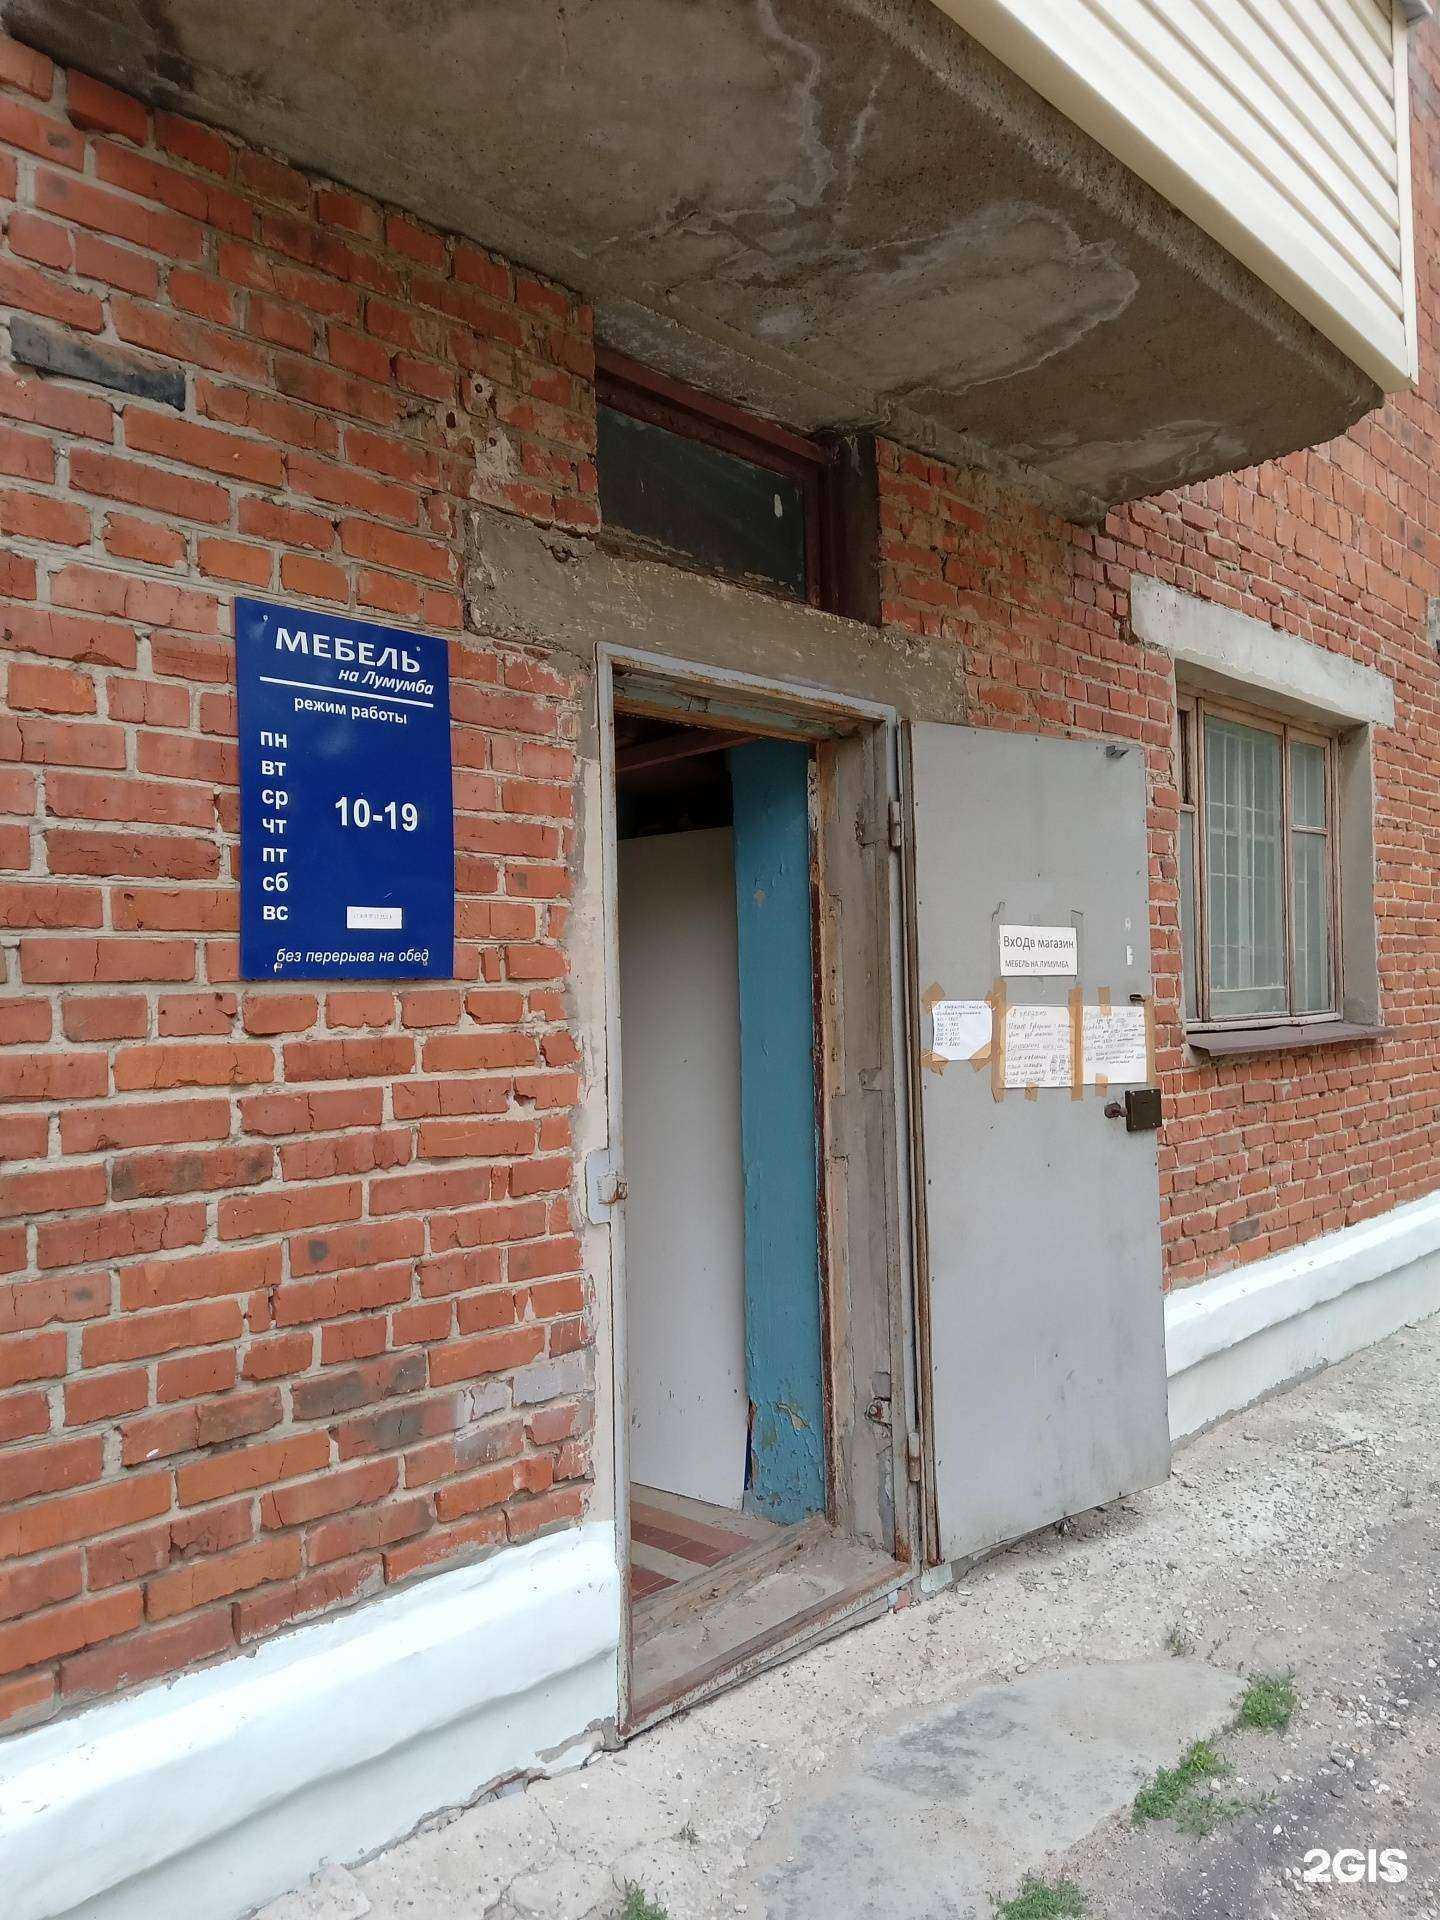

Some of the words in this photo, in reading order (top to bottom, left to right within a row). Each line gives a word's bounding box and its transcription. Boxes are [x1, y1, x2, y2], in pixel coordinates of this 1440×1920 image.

[275, 627, 421, 674] МЕБЕЛЬ
[338, 668, 358, 683] на
[361, 670, 434, 695] Лумумба
[294, 697, 347, 715] режим
[351, 706, 408, 725] работы
[260, 731, 288, 749] пн
[261, 760, 287, 776] вт
[261, 789, 289, 809] ср
[334, 796, 418, 832] 10-19
[262, 818, 287, 834] чт
[262, 847, 288, 863] пт
[262, 872, 289, 892] сб
[262, 905, 289, 921] вс
[1037, 939, 1074, 949] магазин
[276, 948, 301, 962] без
[305, 951, 375, 965] перерыва
[378, 951, 394, 962] на
[398, 948, 429, 963] обед
[1005, 959, 1030, 968] МЕБЕЛЬ
